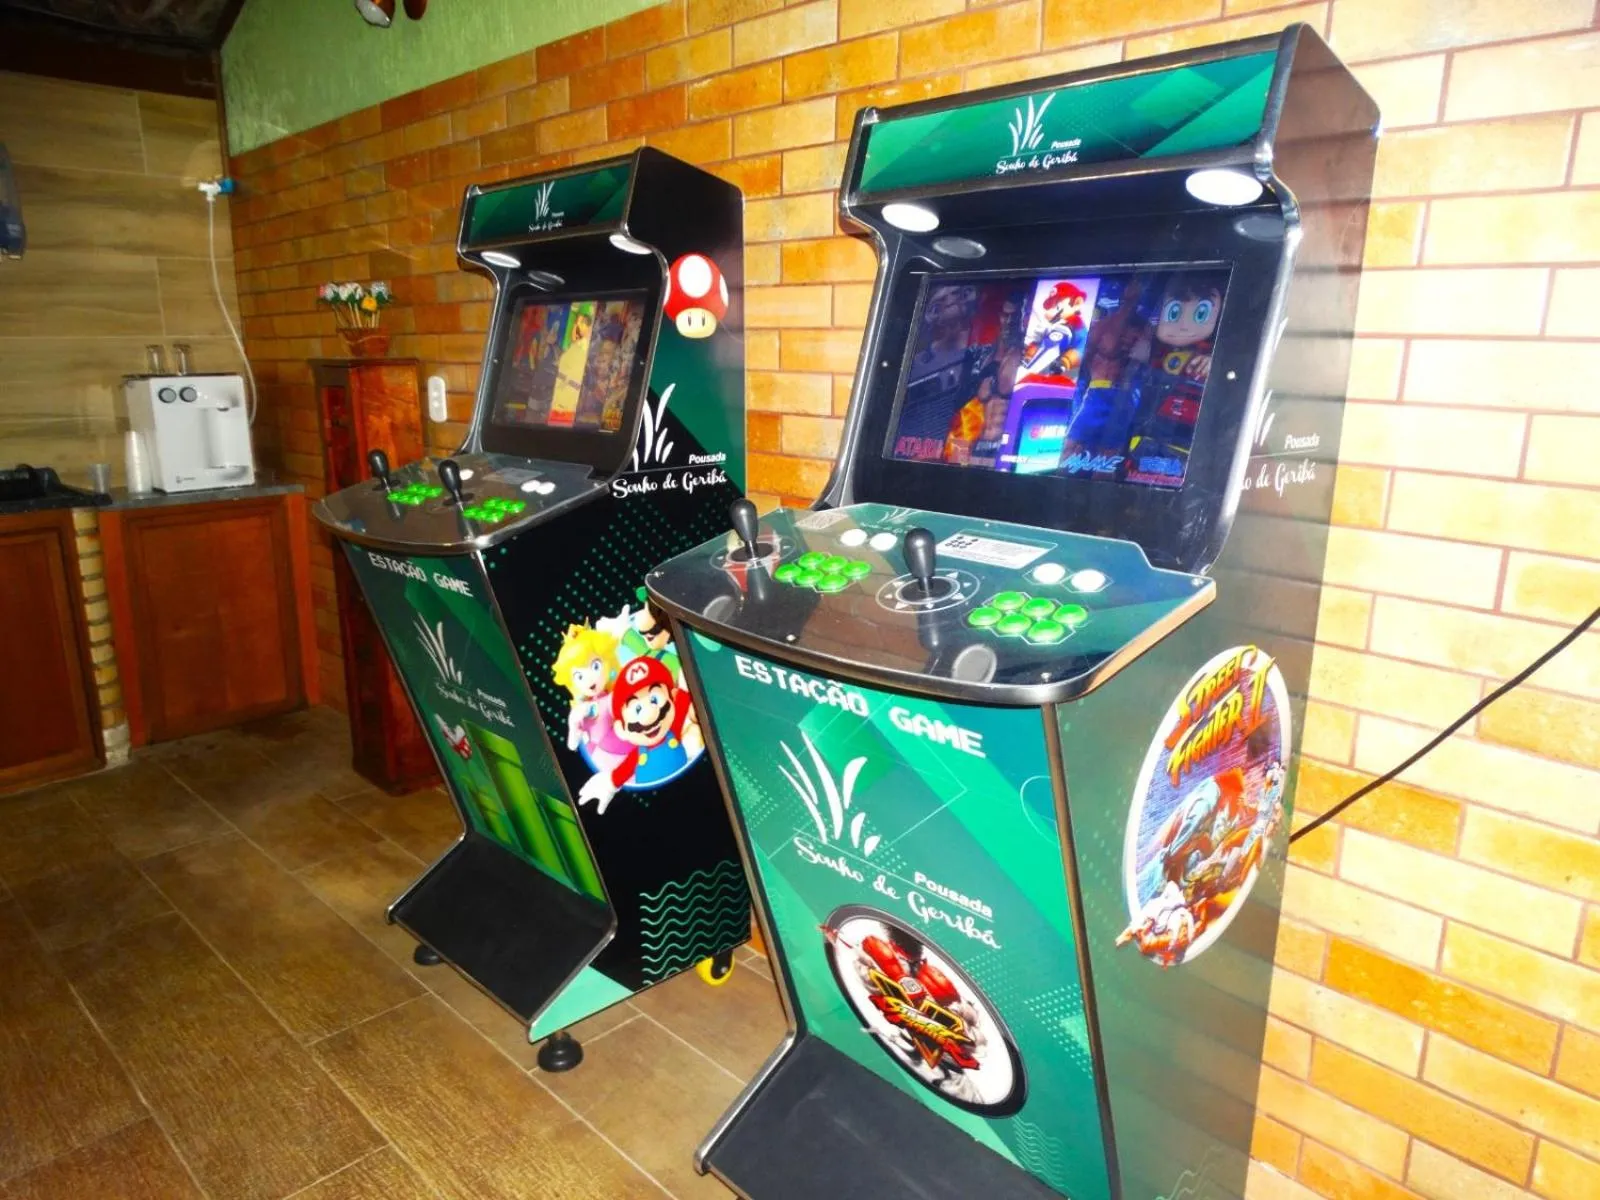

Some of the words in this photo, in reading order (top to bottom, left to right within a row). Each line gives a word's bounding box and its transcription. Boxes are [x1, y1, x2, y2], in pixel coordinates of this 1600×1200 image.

[1029, 155, 1041, 169] de
[689, 452, 727, 465] Pousada
[612, 476, 658, 498] Sonho
[662, 473, 678, 489] de
[682, 468, 728, 494] Geribá
[433, 571, 474, 598] GAME
[888, 705, 986, 759] GAME
[793, 836, 864, 883] Sonho
[872, 874, 901, 900] de
[907, 890, 1003, 950] Geribá
[914, 871, 993, 919] Pousada
